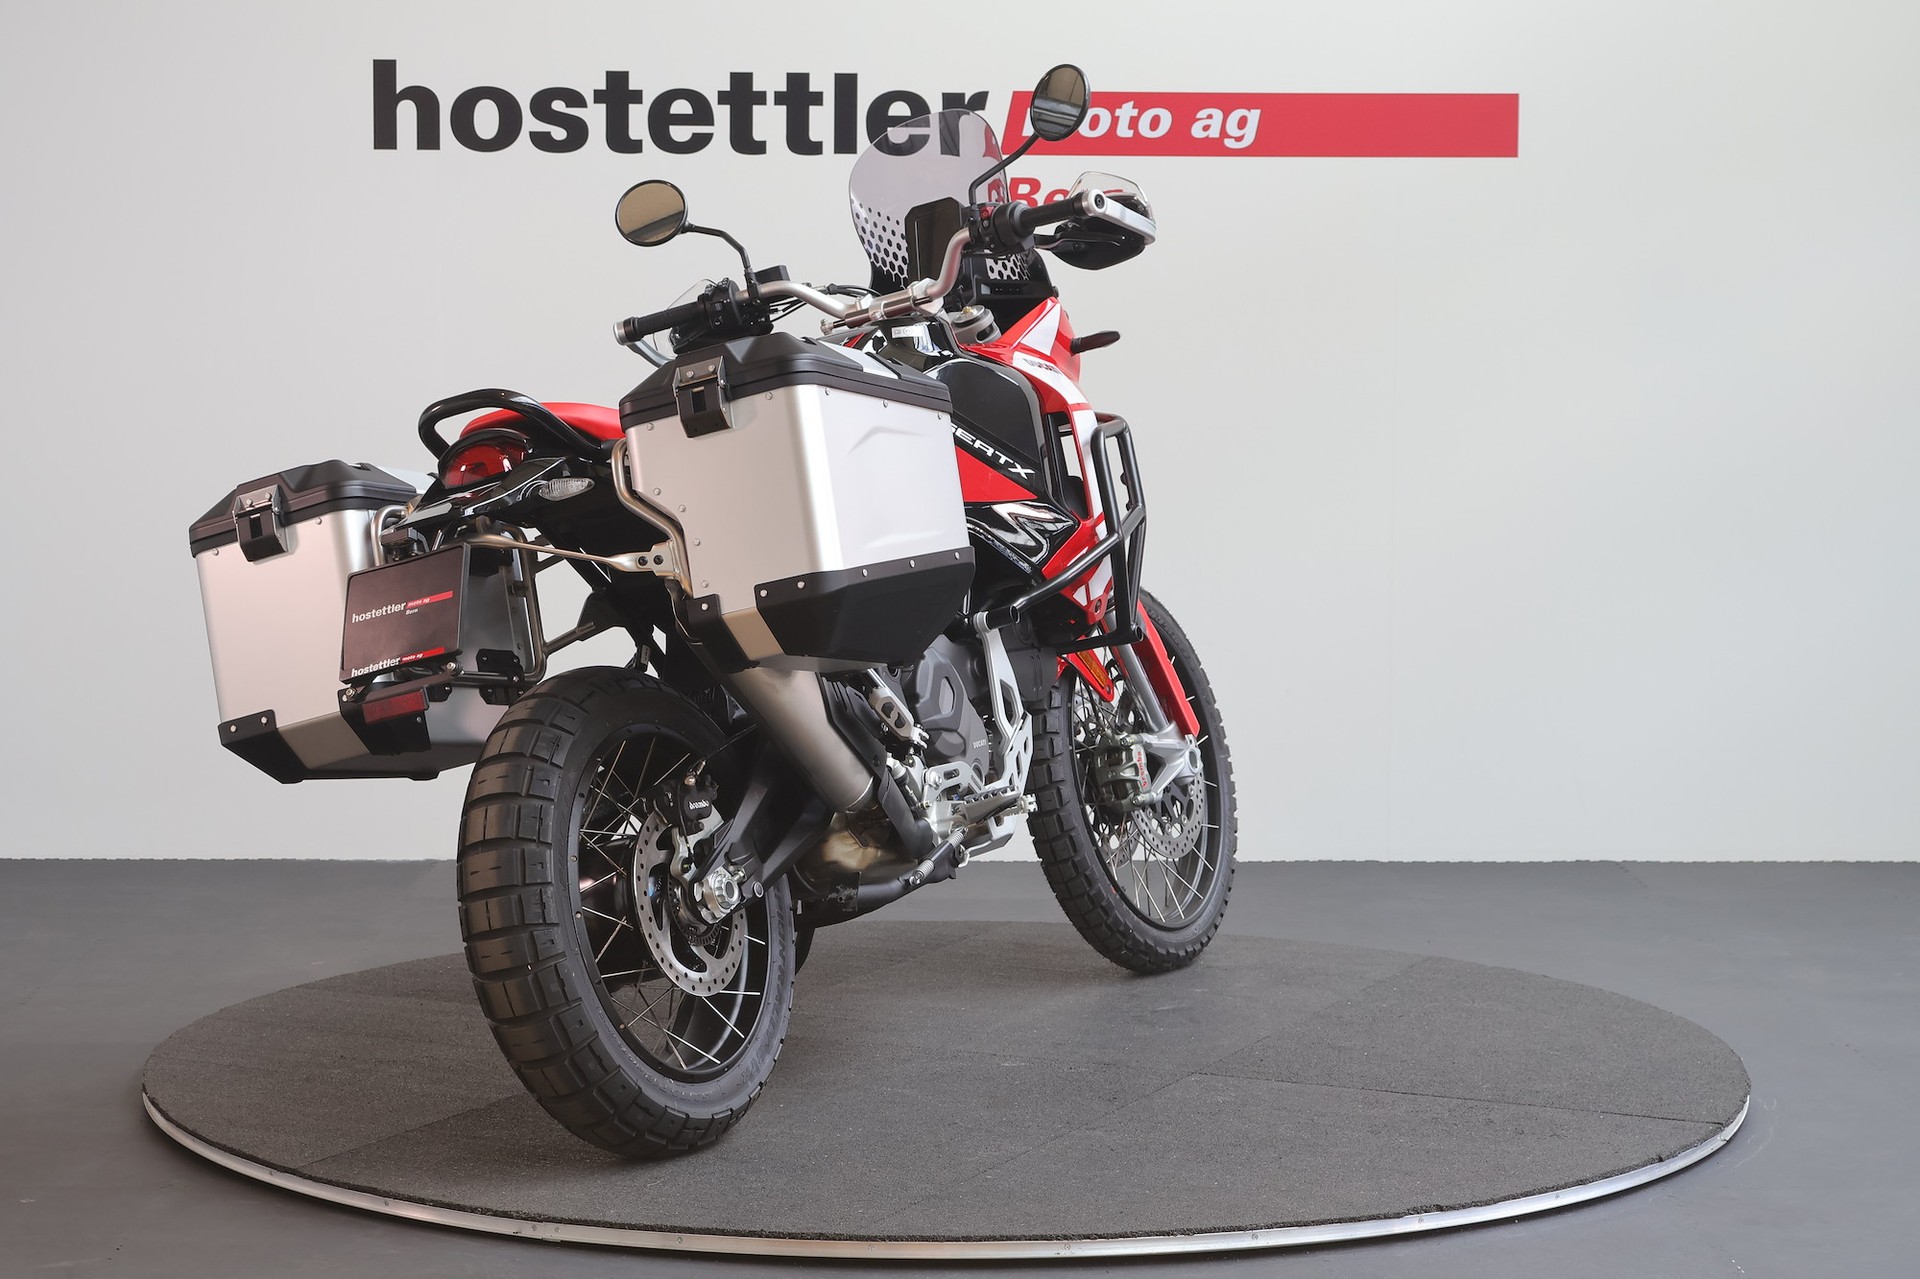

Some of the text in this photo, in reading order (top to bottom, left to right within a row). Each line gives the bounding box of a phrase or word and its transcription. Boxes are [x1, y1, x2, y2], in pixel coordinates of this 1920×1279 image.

[372, 58, 1262, 157] hostettler oto ag
[351, 602, 407, 624] hostettler
[350, 656, 401, 678] hostettler
